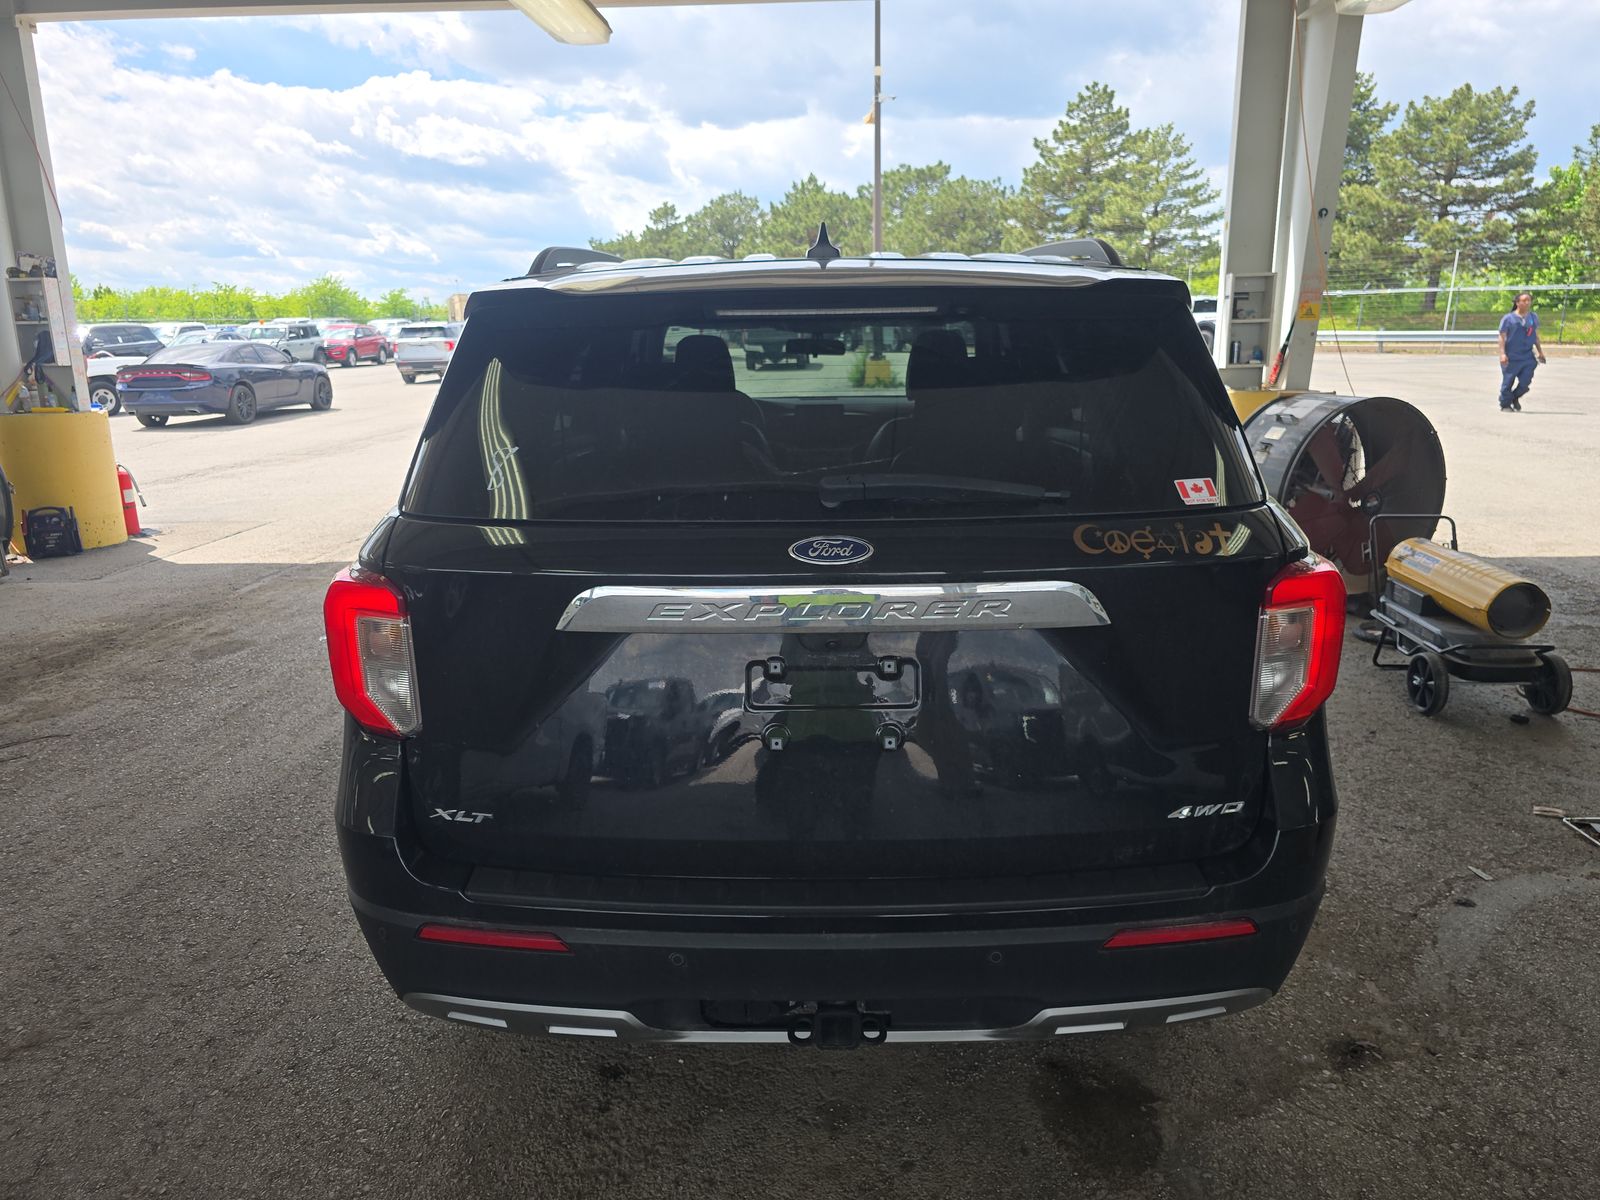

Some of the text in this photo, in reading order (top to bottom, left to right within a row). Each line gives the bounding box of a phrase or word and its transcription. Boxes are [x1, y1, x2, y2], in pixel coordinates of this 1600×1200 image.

[808, 540, 854, 557] Ford
[646, 599, 1013, 622] EXPLORER
[429, 808, 493, 824] XLT
[1167, 801, 1245, 819] 4WD
